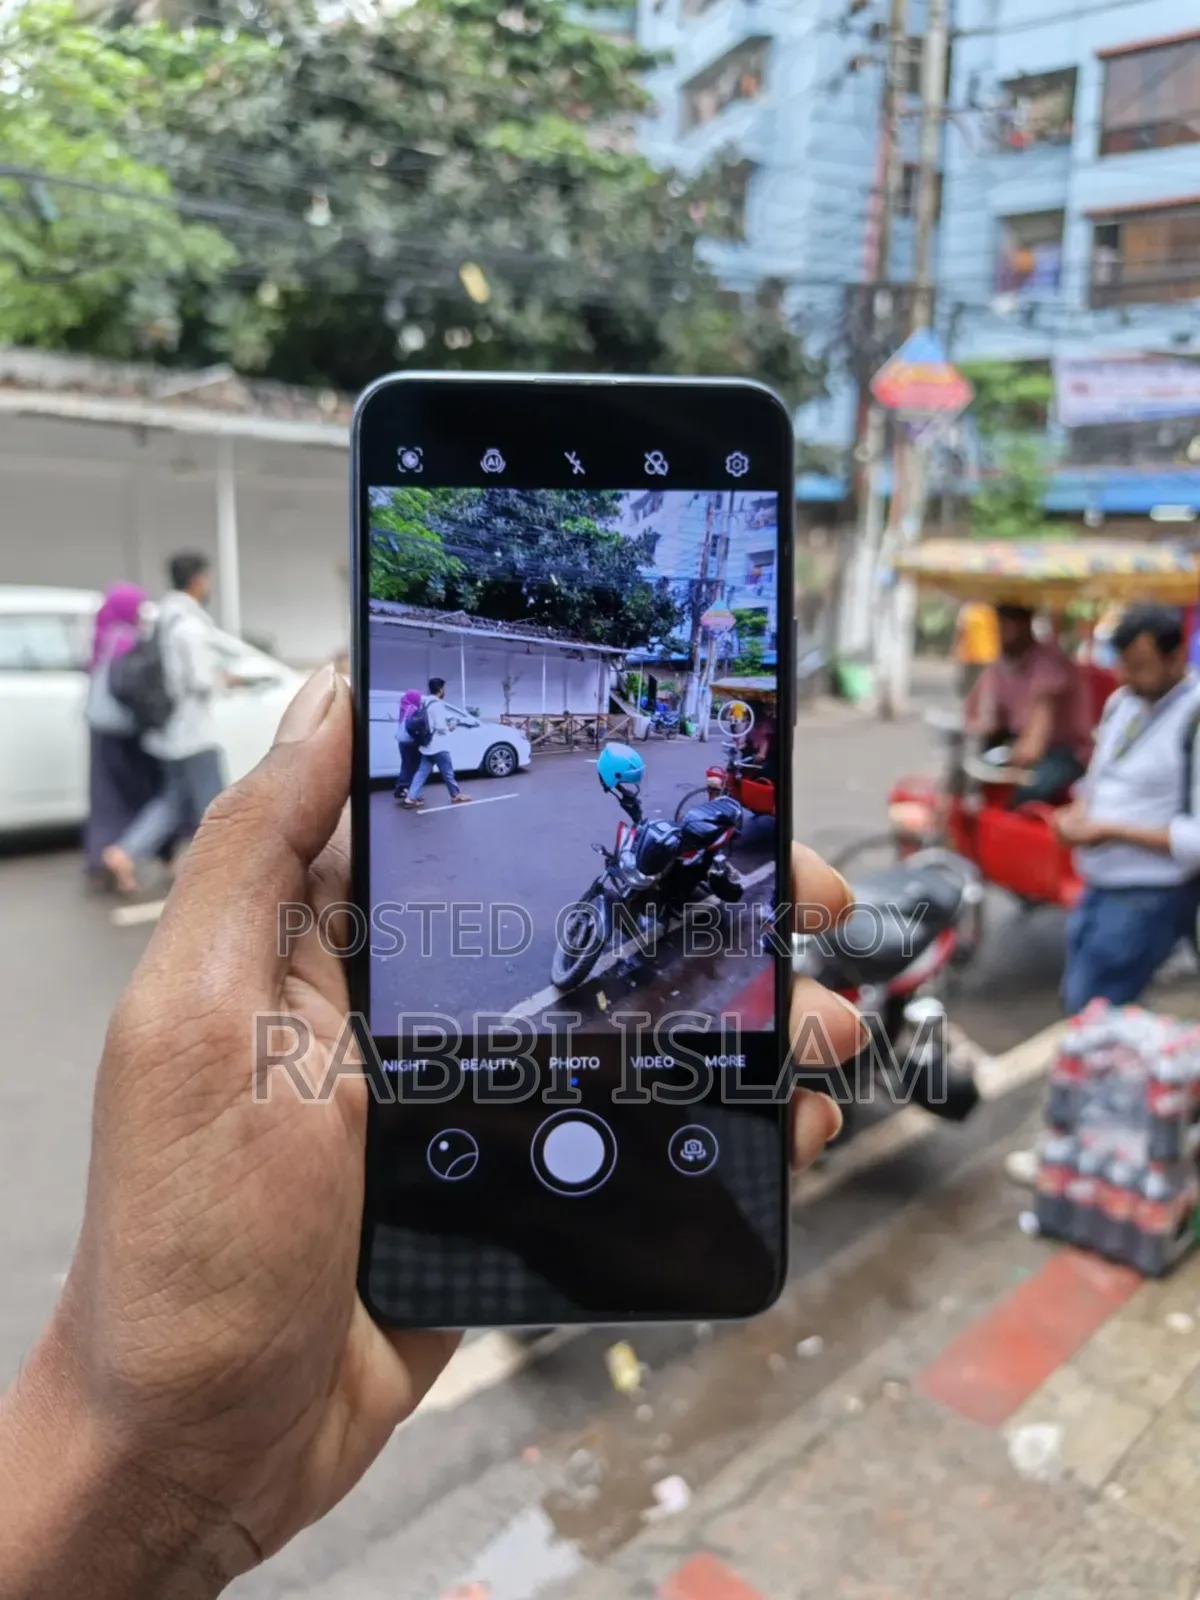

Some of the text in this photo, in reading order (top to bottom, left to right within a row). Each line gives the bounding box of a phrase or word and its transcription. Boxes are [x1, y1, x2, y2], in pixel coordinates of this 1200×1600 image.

[382, 1054, 746, 1072] NIGHT BEAUTY PHOTO VIDEO MORE
